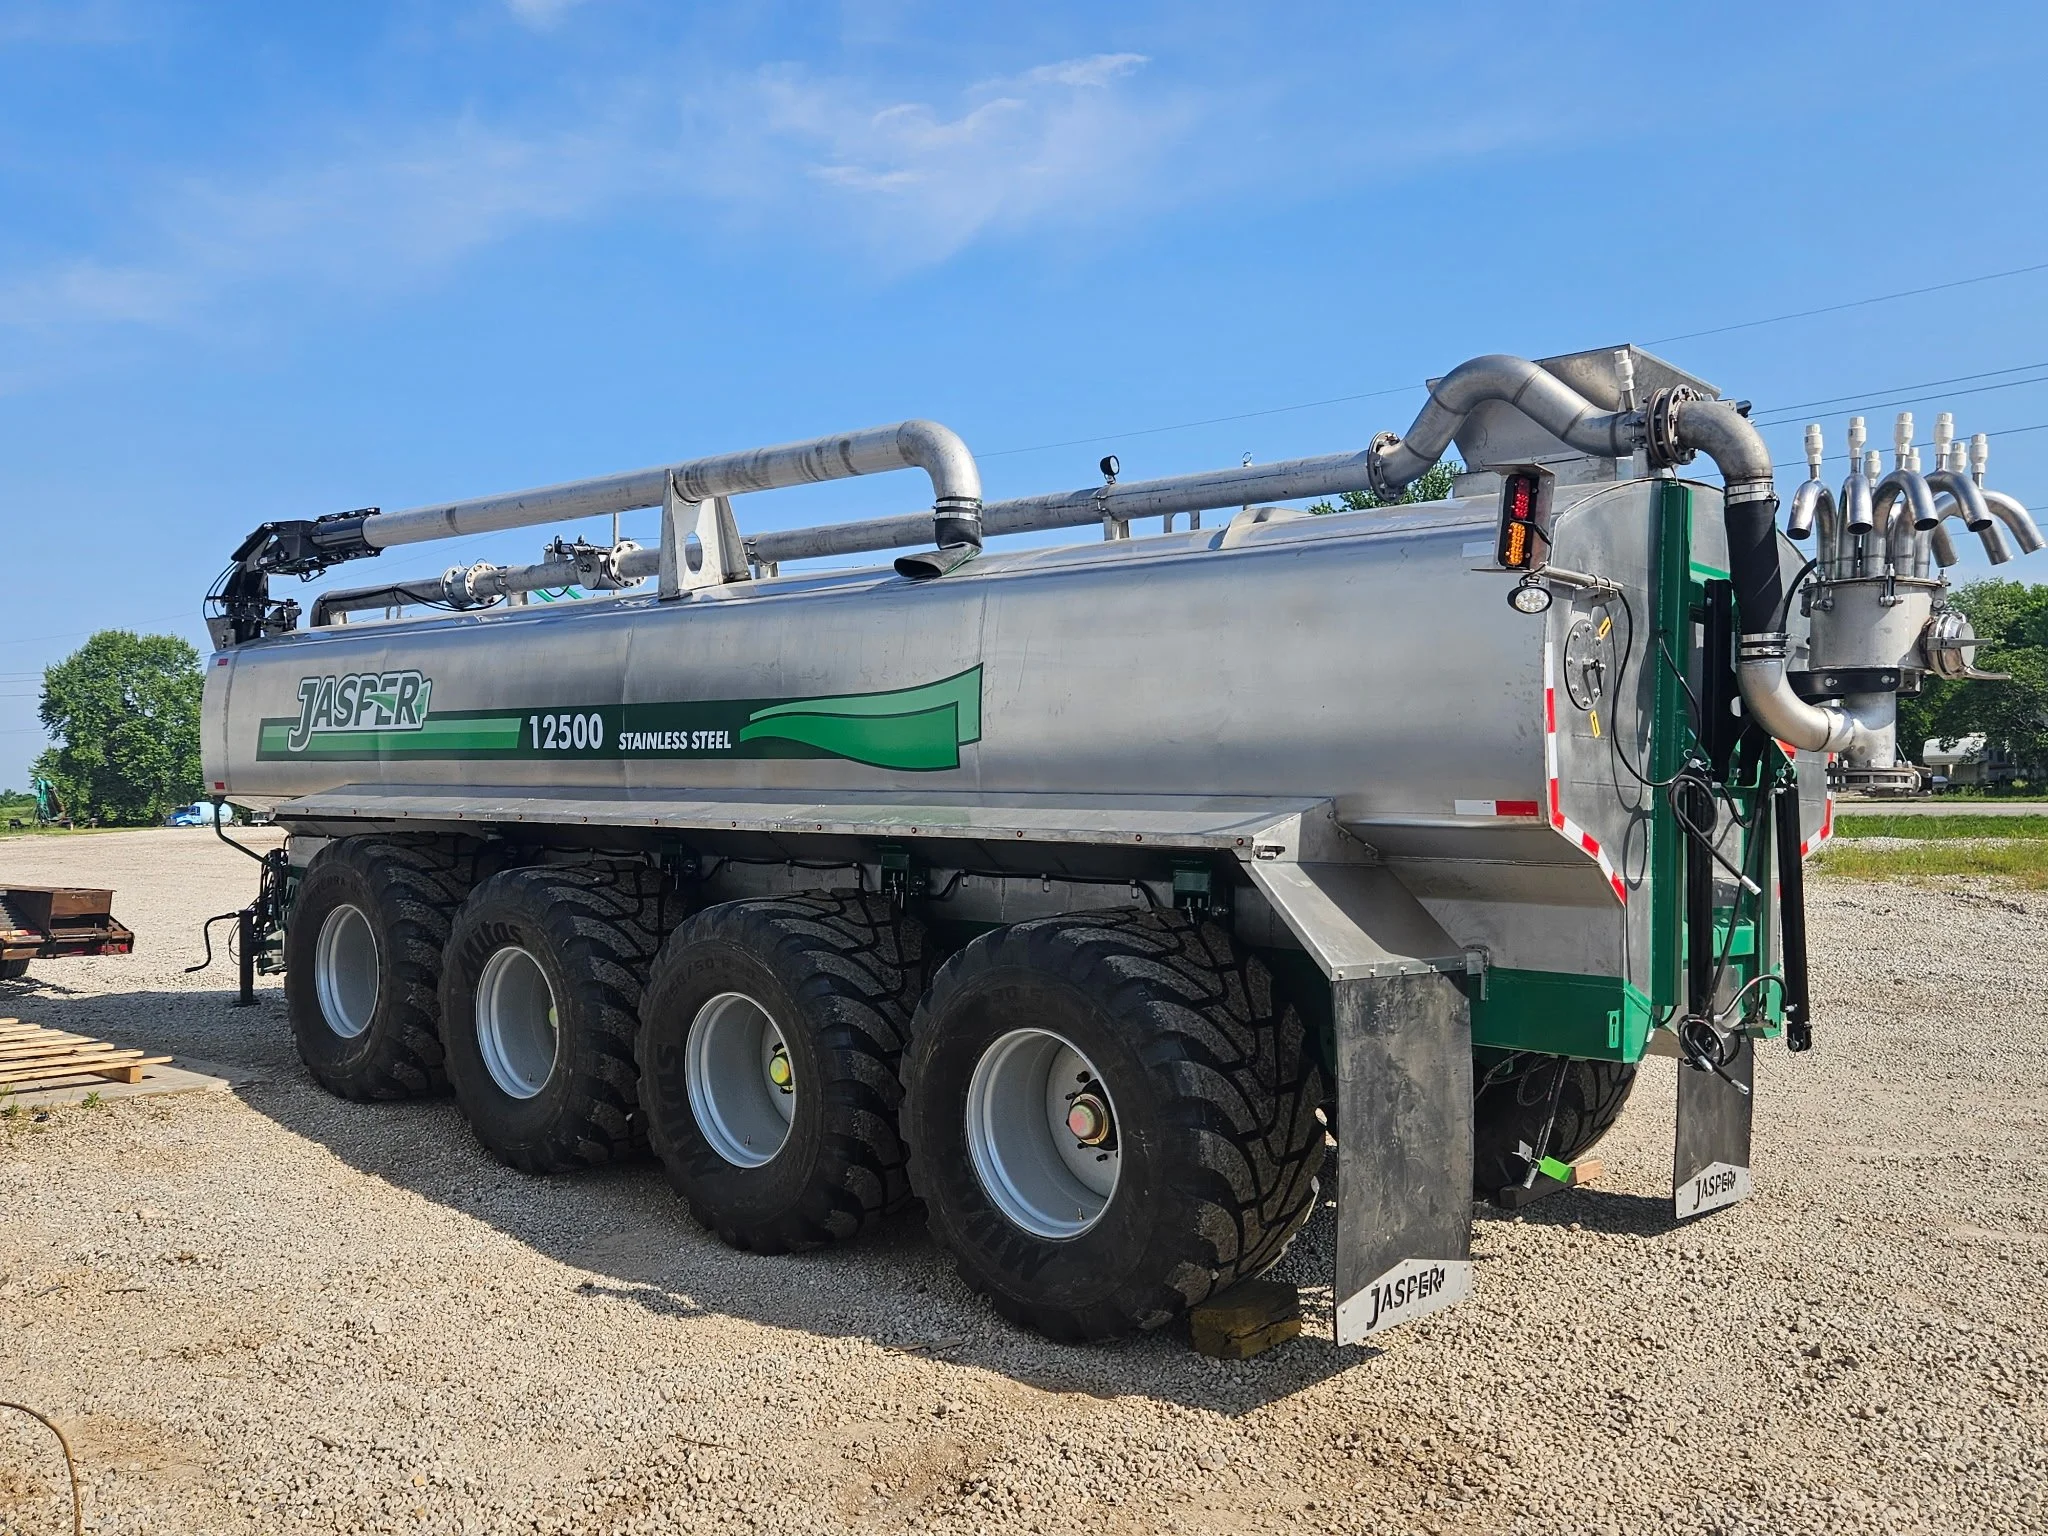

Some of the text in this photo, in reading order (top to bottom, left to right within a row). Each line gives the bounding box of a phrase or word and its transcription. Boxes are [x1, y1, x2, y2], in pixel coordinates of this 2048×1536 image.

[288, 671, 428, 750] JASPER
[529, 713, 732, 751] 12500 STAINLESS STEEL
[458, 920, 525, 986] Mitas
[1691, 1170, 1735, 1210] JASPER
[1366, 1268, 1443, 1331] JASPER
